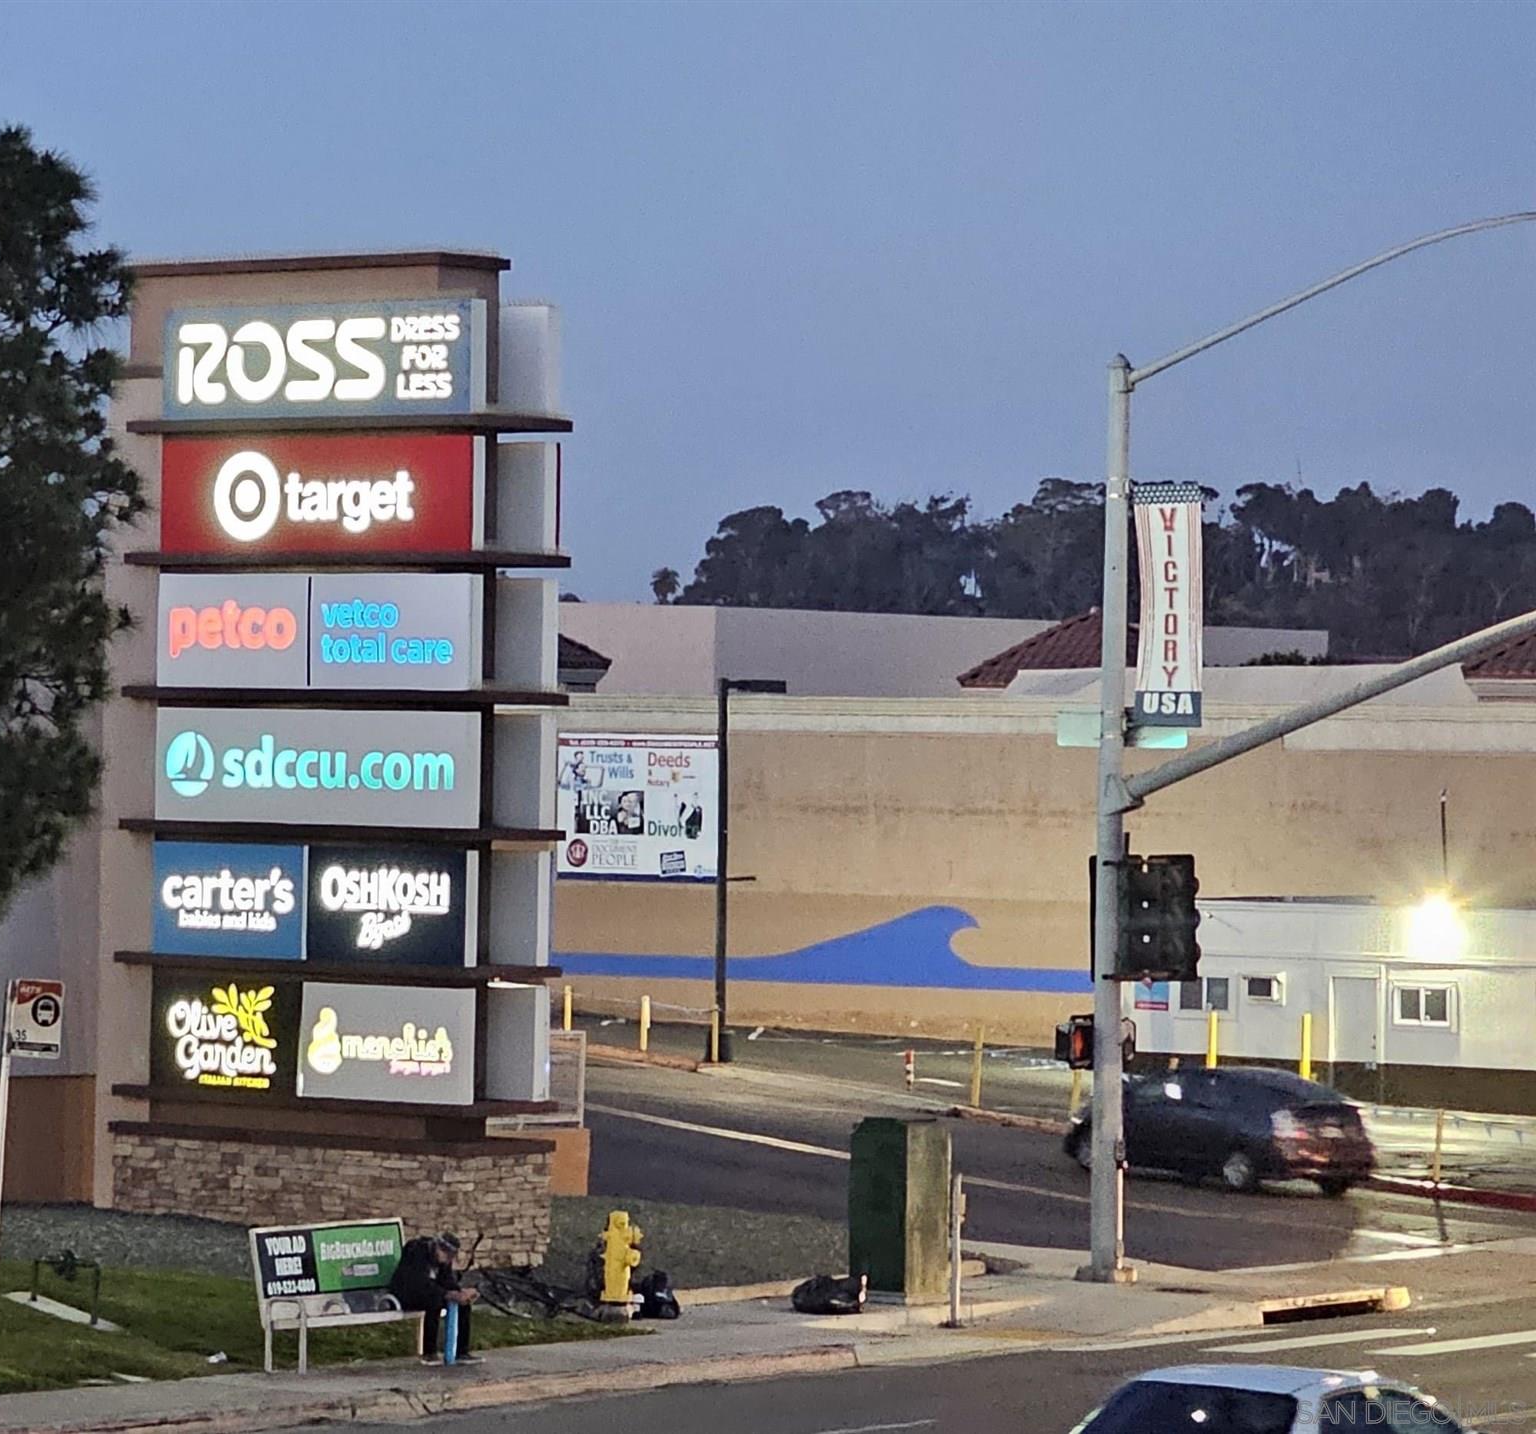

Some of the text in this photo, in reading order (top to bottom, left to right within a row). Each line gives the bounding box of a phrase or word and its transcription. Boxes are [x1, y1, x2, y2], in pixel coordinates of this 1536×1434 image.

[390, 313, 461, 341] DRESS
[178, 316, 386, 404] ROSS
[401, 344, 449, 371] FOR
[396, 371, 453, 399] LESS
[284, 470, 415, 533] target
[1159, 507, 1179, 688] VICTORY
[321, 599, 399, 628] vetco
[169, 600, 297, 658] petco
[321, 633, 454, 664] total care
[1142, 692, 1194, 714] USA
[221, 734, 455, 791] sdccu.com
[589, 751, 624, 764] Trusts
[648, 752, 691, 768] Deeds
[608, 767, 635, 779] Wills
[586, 805, 611, 820] LLC
[590, 820, 618, 834] DBA
[592, 854, 639, 867] PEOPLE
[162, 867, 295, 914] carter's
[167, 999, 238, 1041] Olive
[15, 1029, 27, 1041] 35
[175, 1034, 277, 1079] Garden
[265, 1236, 306, 1256] YOUR AD
